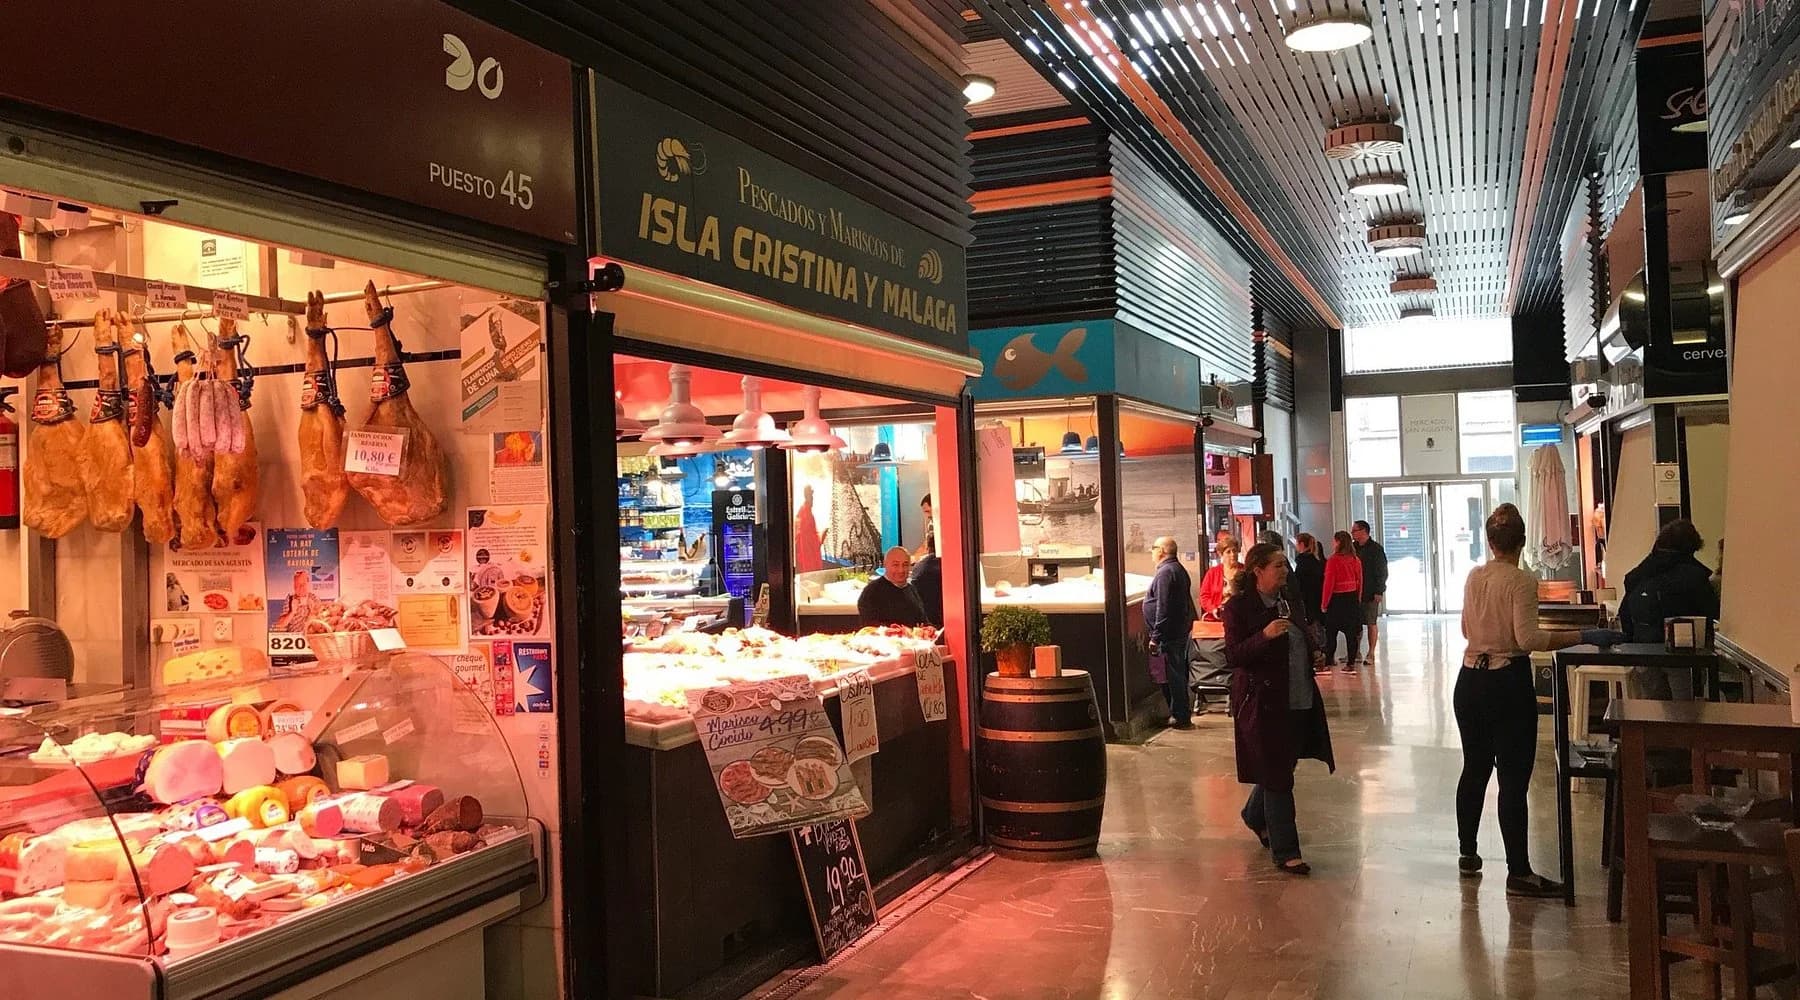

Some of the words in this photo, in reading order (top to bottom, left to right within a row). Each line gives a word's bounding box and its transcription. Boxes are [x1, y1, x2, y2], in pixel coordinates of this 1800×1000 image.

[430, 162, 495, 200] PUESTO
[500, 169, 534, 210] 45
[638, 192, 722, 262] ISLA
[732, 225, 859, 304] CRISTINA
[863, 271, 880, 309] Y
[882, 279, 958, 335] MALAGA
[889, 243, 906, 269] DE
[467, 383, 479, 395] DE
[479, 367, 500, 386] CUNA
[354, 449, 385, 462] 10,80
[388, 452, 396, 463] €
[173, 559, 203, 567] MERCADO
[310, 549, 319, 557] DE
[455, 663, 485, 673] gourmet
[709, 729, 753, 751] Cocido
